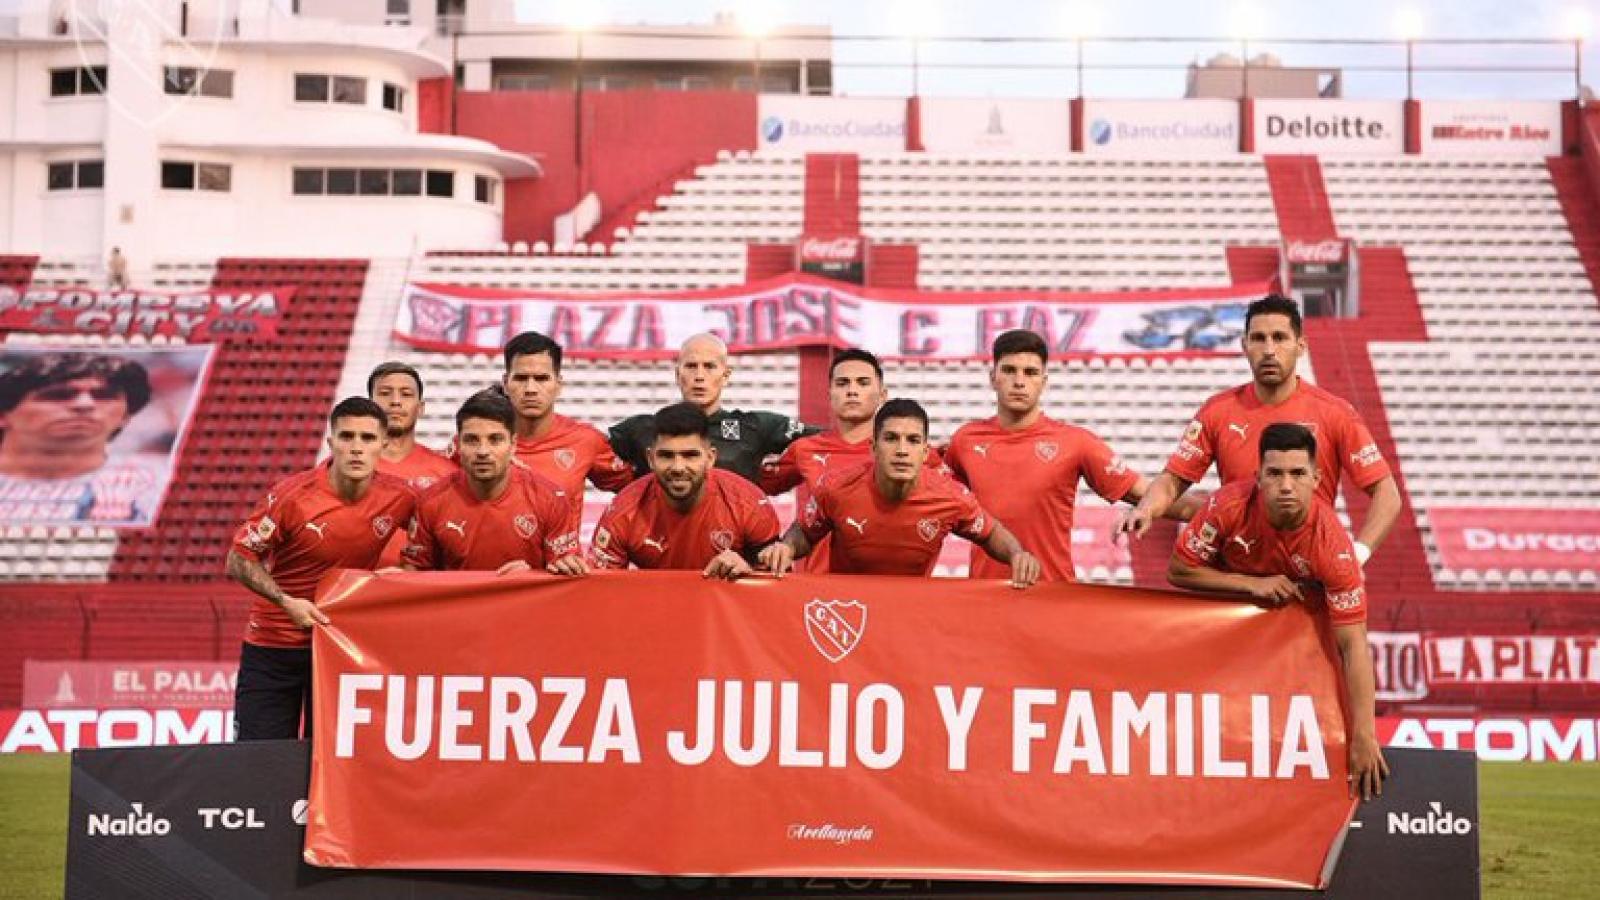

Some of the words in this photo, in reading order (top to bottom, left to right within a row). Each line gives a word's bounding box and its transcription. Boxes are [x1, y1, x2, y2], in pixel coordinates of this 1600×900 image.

[459, 303, 664, 349] PLAZA
[899, 309, 940, 355] C
[976, 305, 1099, 354] PAZ
[113, 670, 146, 692] EL
[334, 673, 641, 763] FUERZA
[666, 679, 905, 770] JULIO
[933, 685, 983, 771] Y
[1011, 688, 1330, 780] FAMILIA
[1389, 717, 1600, 761] ATOM
[87, 804, 171, 837] Naldo
[197, 807, 265, 829] TCL
[1387, 803, 1472, 835] Naldo
